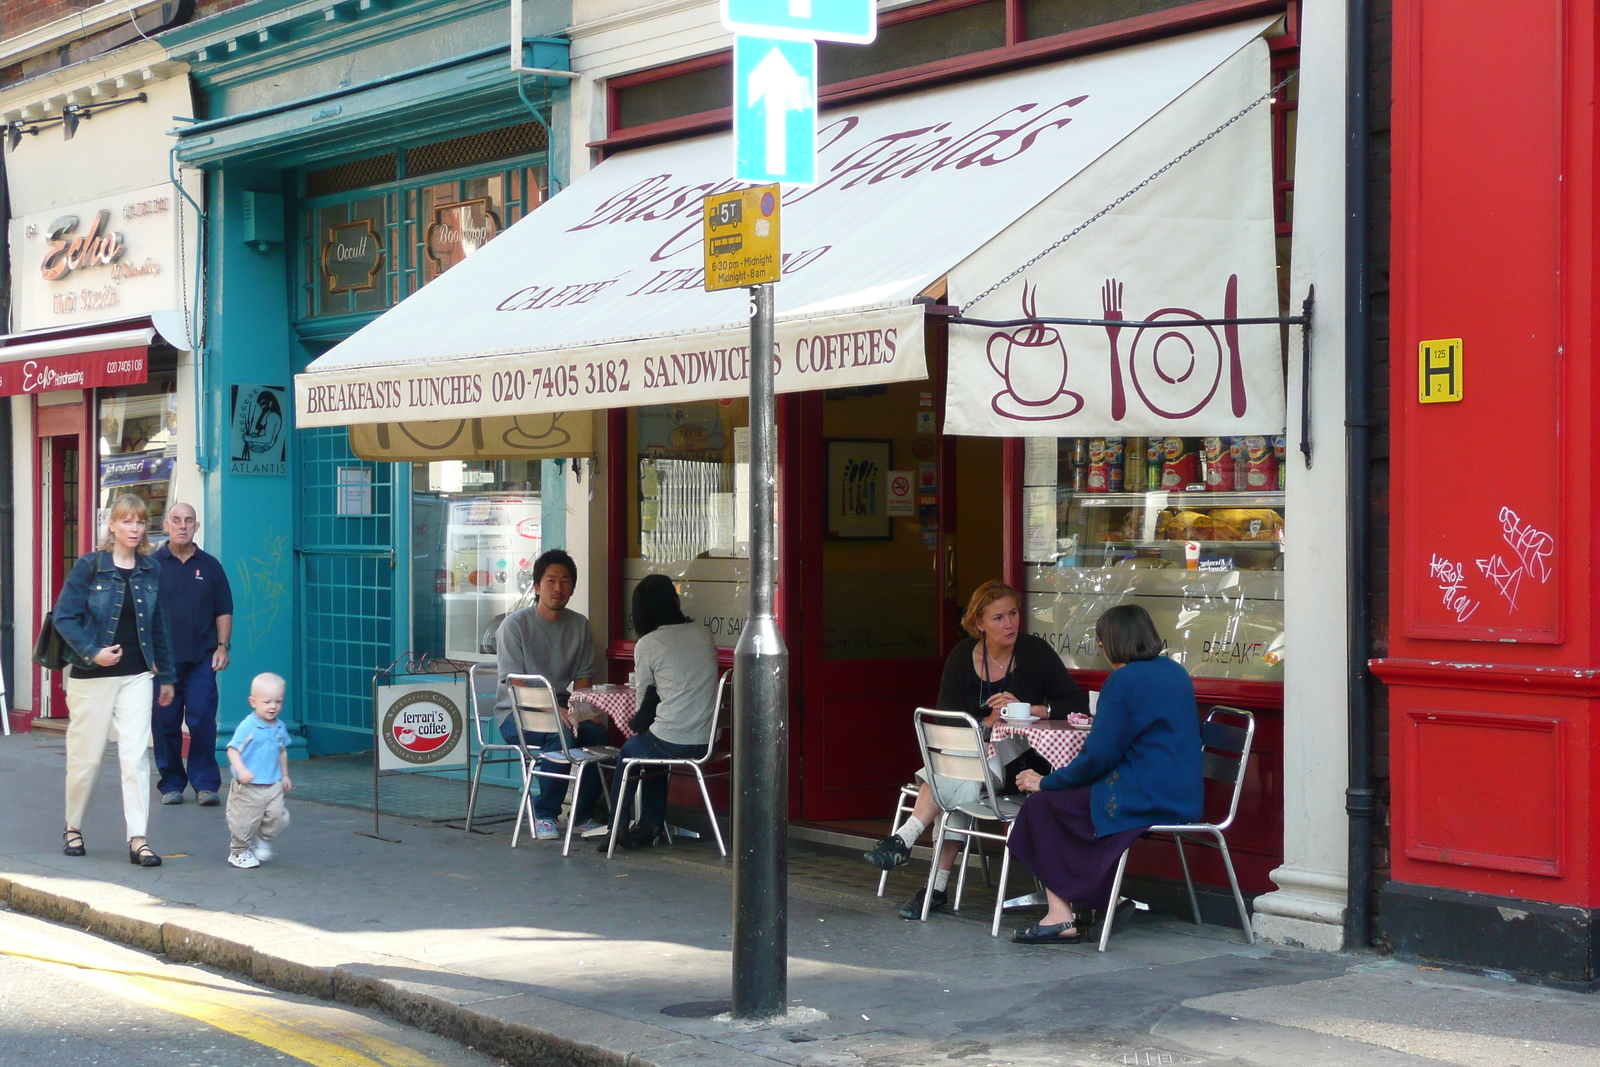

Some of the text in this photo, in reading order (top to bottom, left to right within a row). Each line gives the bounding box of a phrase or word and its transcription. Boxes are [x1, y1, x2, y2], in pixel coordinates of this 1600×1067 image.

[438, 221, 488, 247] Bookshop
[41, 208, 127, 281] Echo
[336, 236, 368, 261] Occult
[744, 254, 772, 267] Midnight
[718, 270, 746, 283] Midnight
[1434, 349, 1446, 359] 125
[23, 360, 56, 392] Echo
[306, 327, 898, 414] BREAKFASTS LUNCHES 020-7405 3182 SANDWICHS COFFEES
[1425, 345, 1454, 397] H
[1437, 383, 1442, 393] 2
[231, 462, 287, 474] ATLANTIS
[703, 616, 725, 635] HOT
[403, 710, 444, 724] ferrari's
[418, 723, 447, 735] coffee
